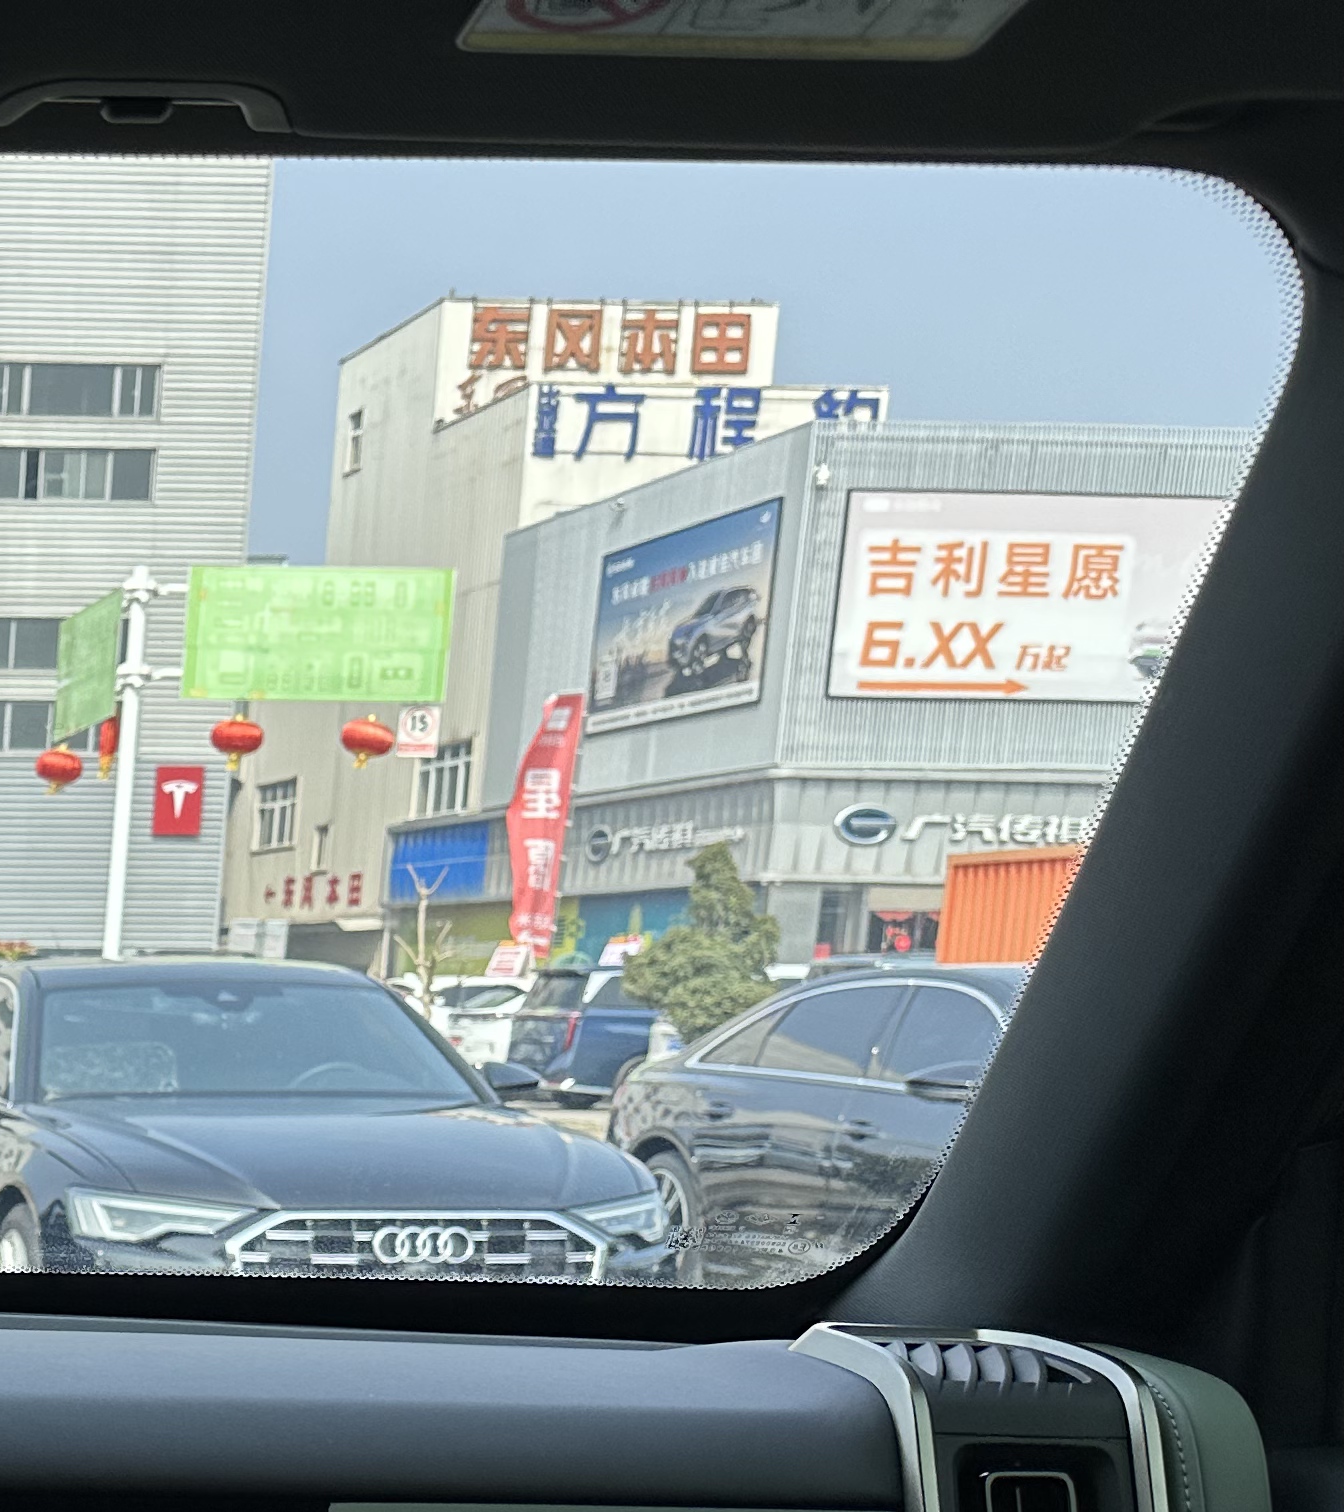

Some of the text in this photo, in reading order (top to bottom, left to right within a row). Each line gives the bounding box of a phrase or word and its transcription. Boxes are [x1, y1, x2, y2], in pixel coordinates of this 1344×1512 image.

[468, 307, 751, 374] 东风本田
[867, 539, 1124, 600] 吉利星愿
[859, 621, 1072, 672] 6.XX 万起
[410, 714, 429, 732] 15
